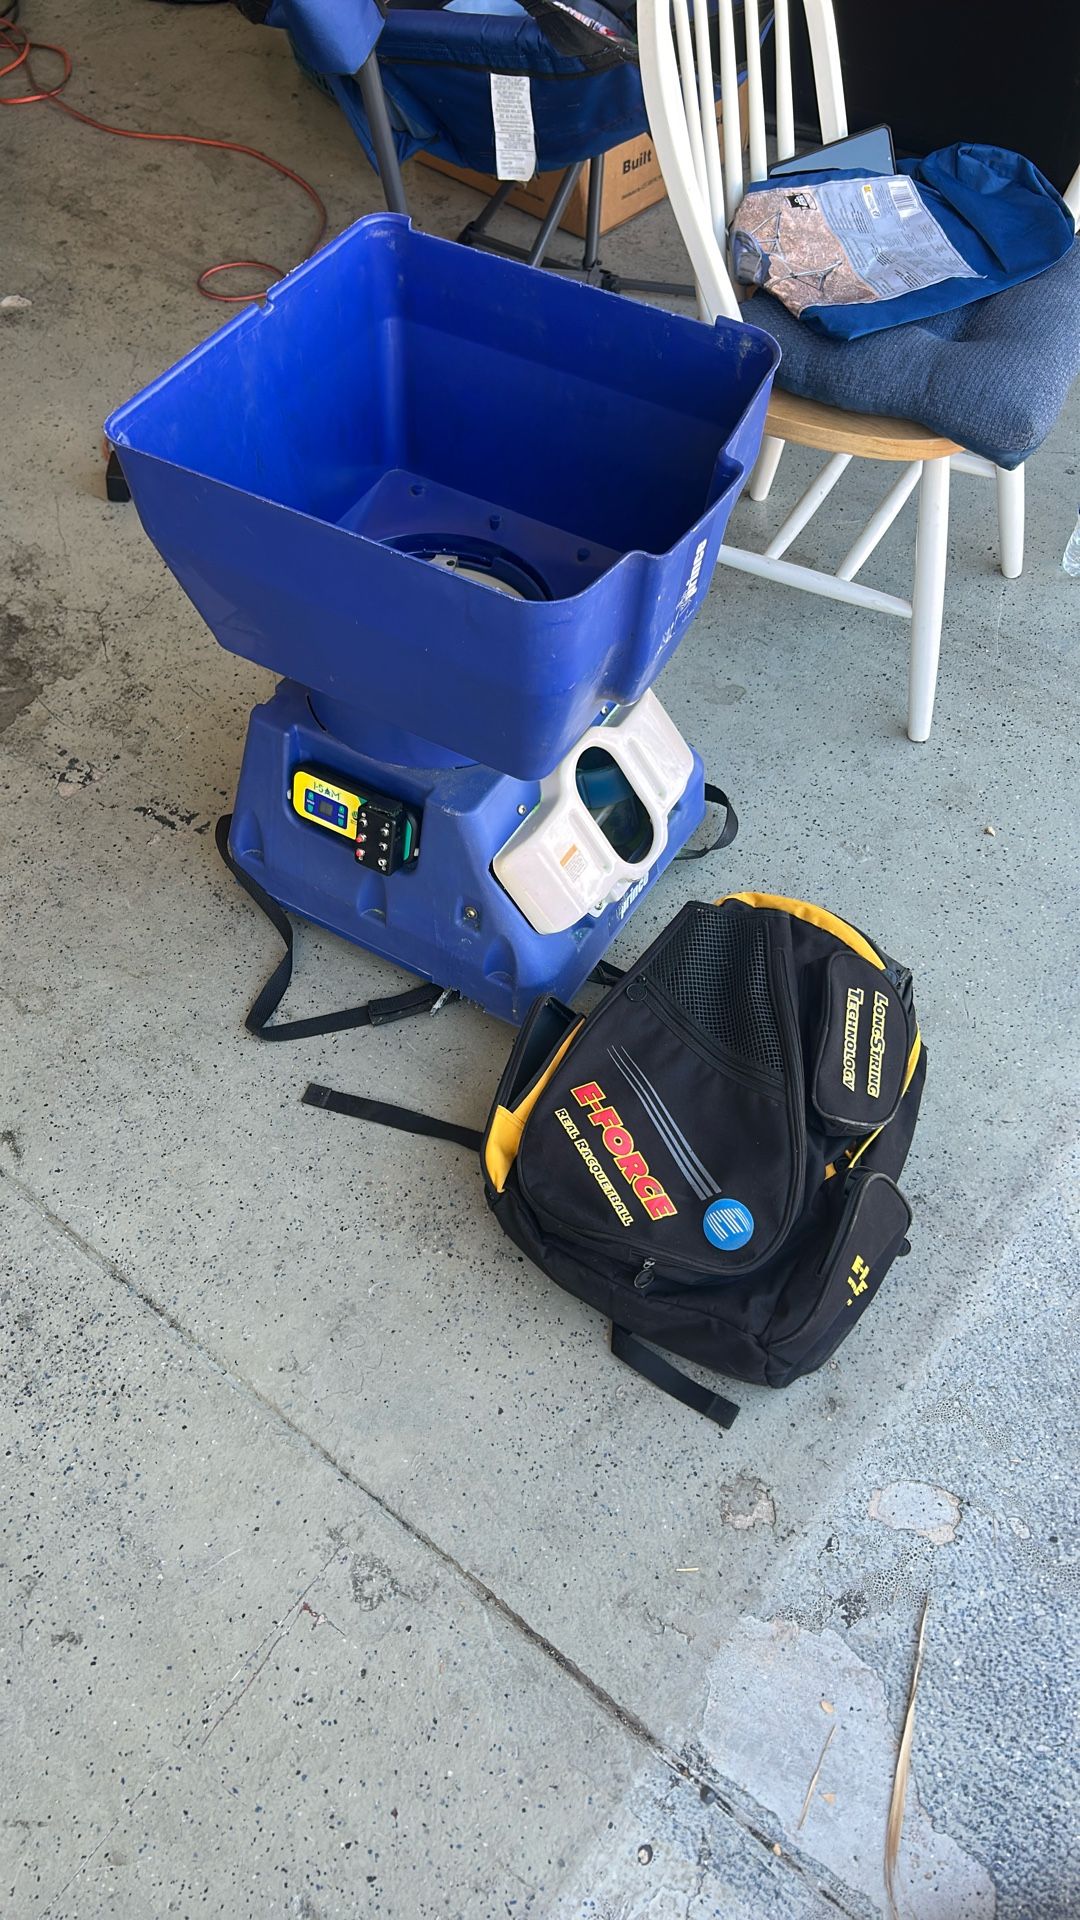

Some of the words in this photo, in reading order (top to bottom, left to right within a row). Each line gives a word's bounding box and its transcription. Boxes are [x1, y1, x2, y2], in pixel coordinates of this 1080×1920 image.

[622, 149, 652, 175] Built
[684, 539, 707, 601] prince
[842, 988, 864, 1092] TECHNOLOGY
[554, 1107, 581, 1140] REAL
[574, 1138, 634, 1227] RACQUETBALL
[570, 1081, 678, 1221] E-FORCE
